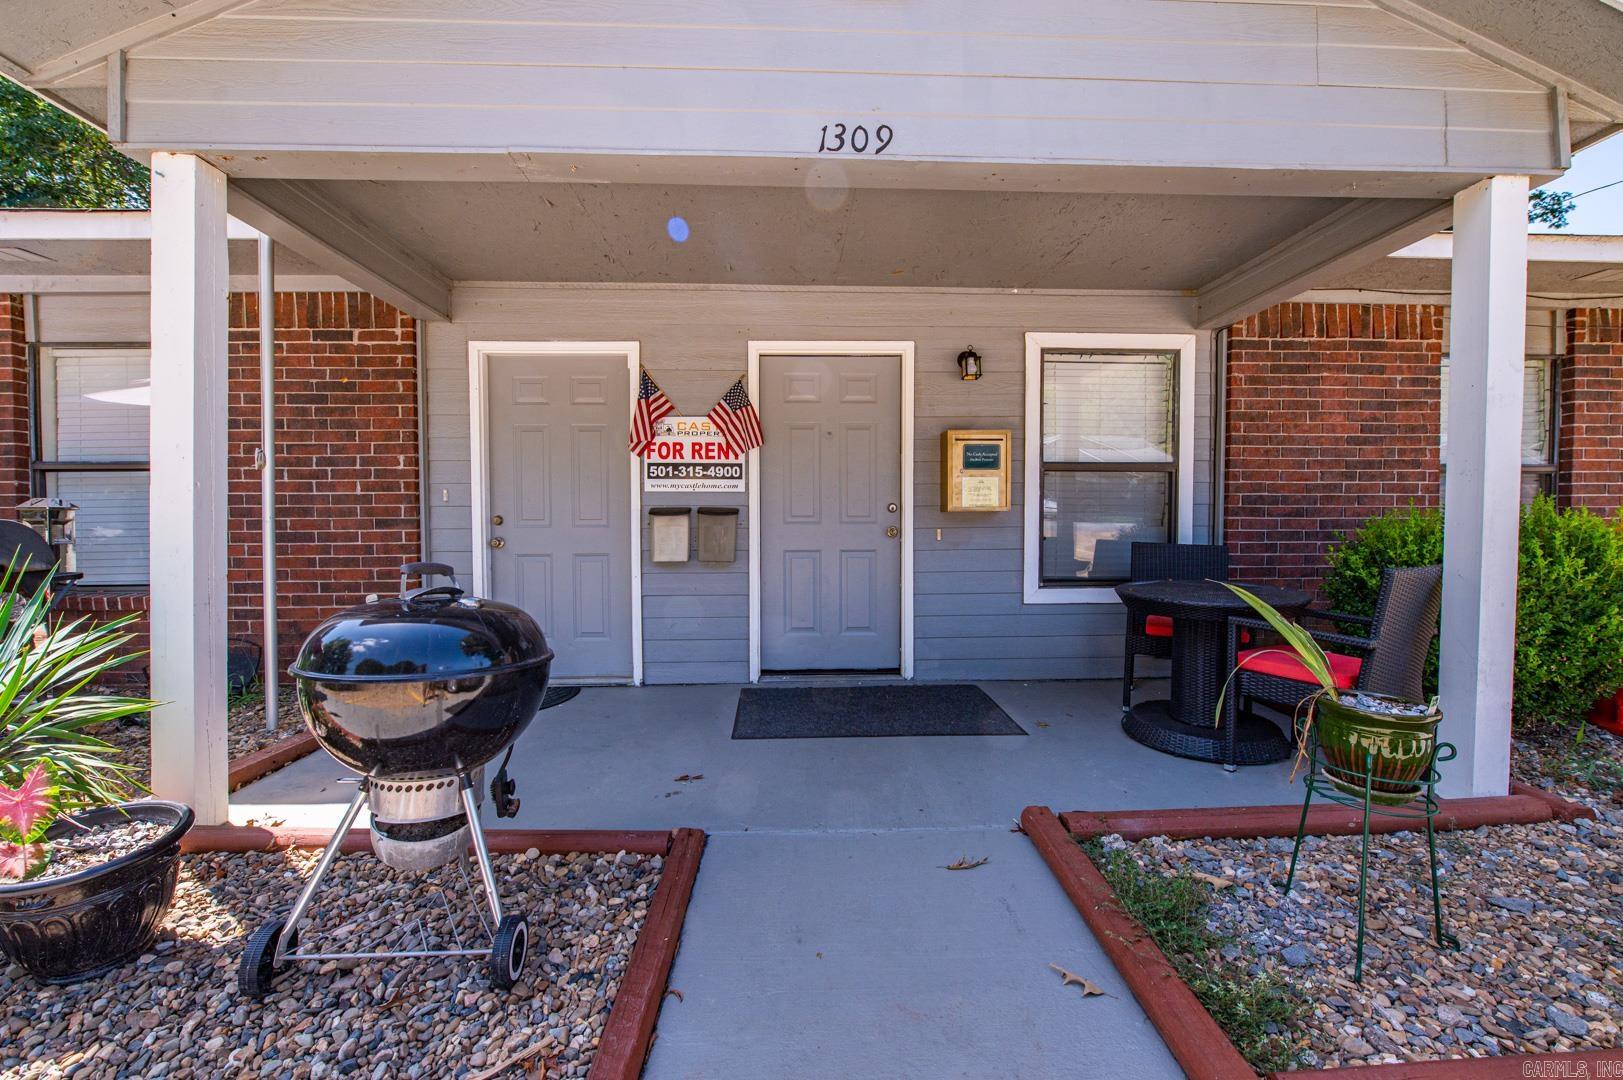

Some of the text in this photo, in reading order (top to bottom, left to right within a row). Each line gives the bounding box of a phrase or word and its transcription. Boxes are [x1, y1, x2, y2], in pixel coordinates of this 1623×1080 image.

[819, 123, 893, 155] 1309
[677, 422, 711, 431] CAS
[646, 442, 685, 460] FOR
[649, 465, 740, 477] 501-315-4900
